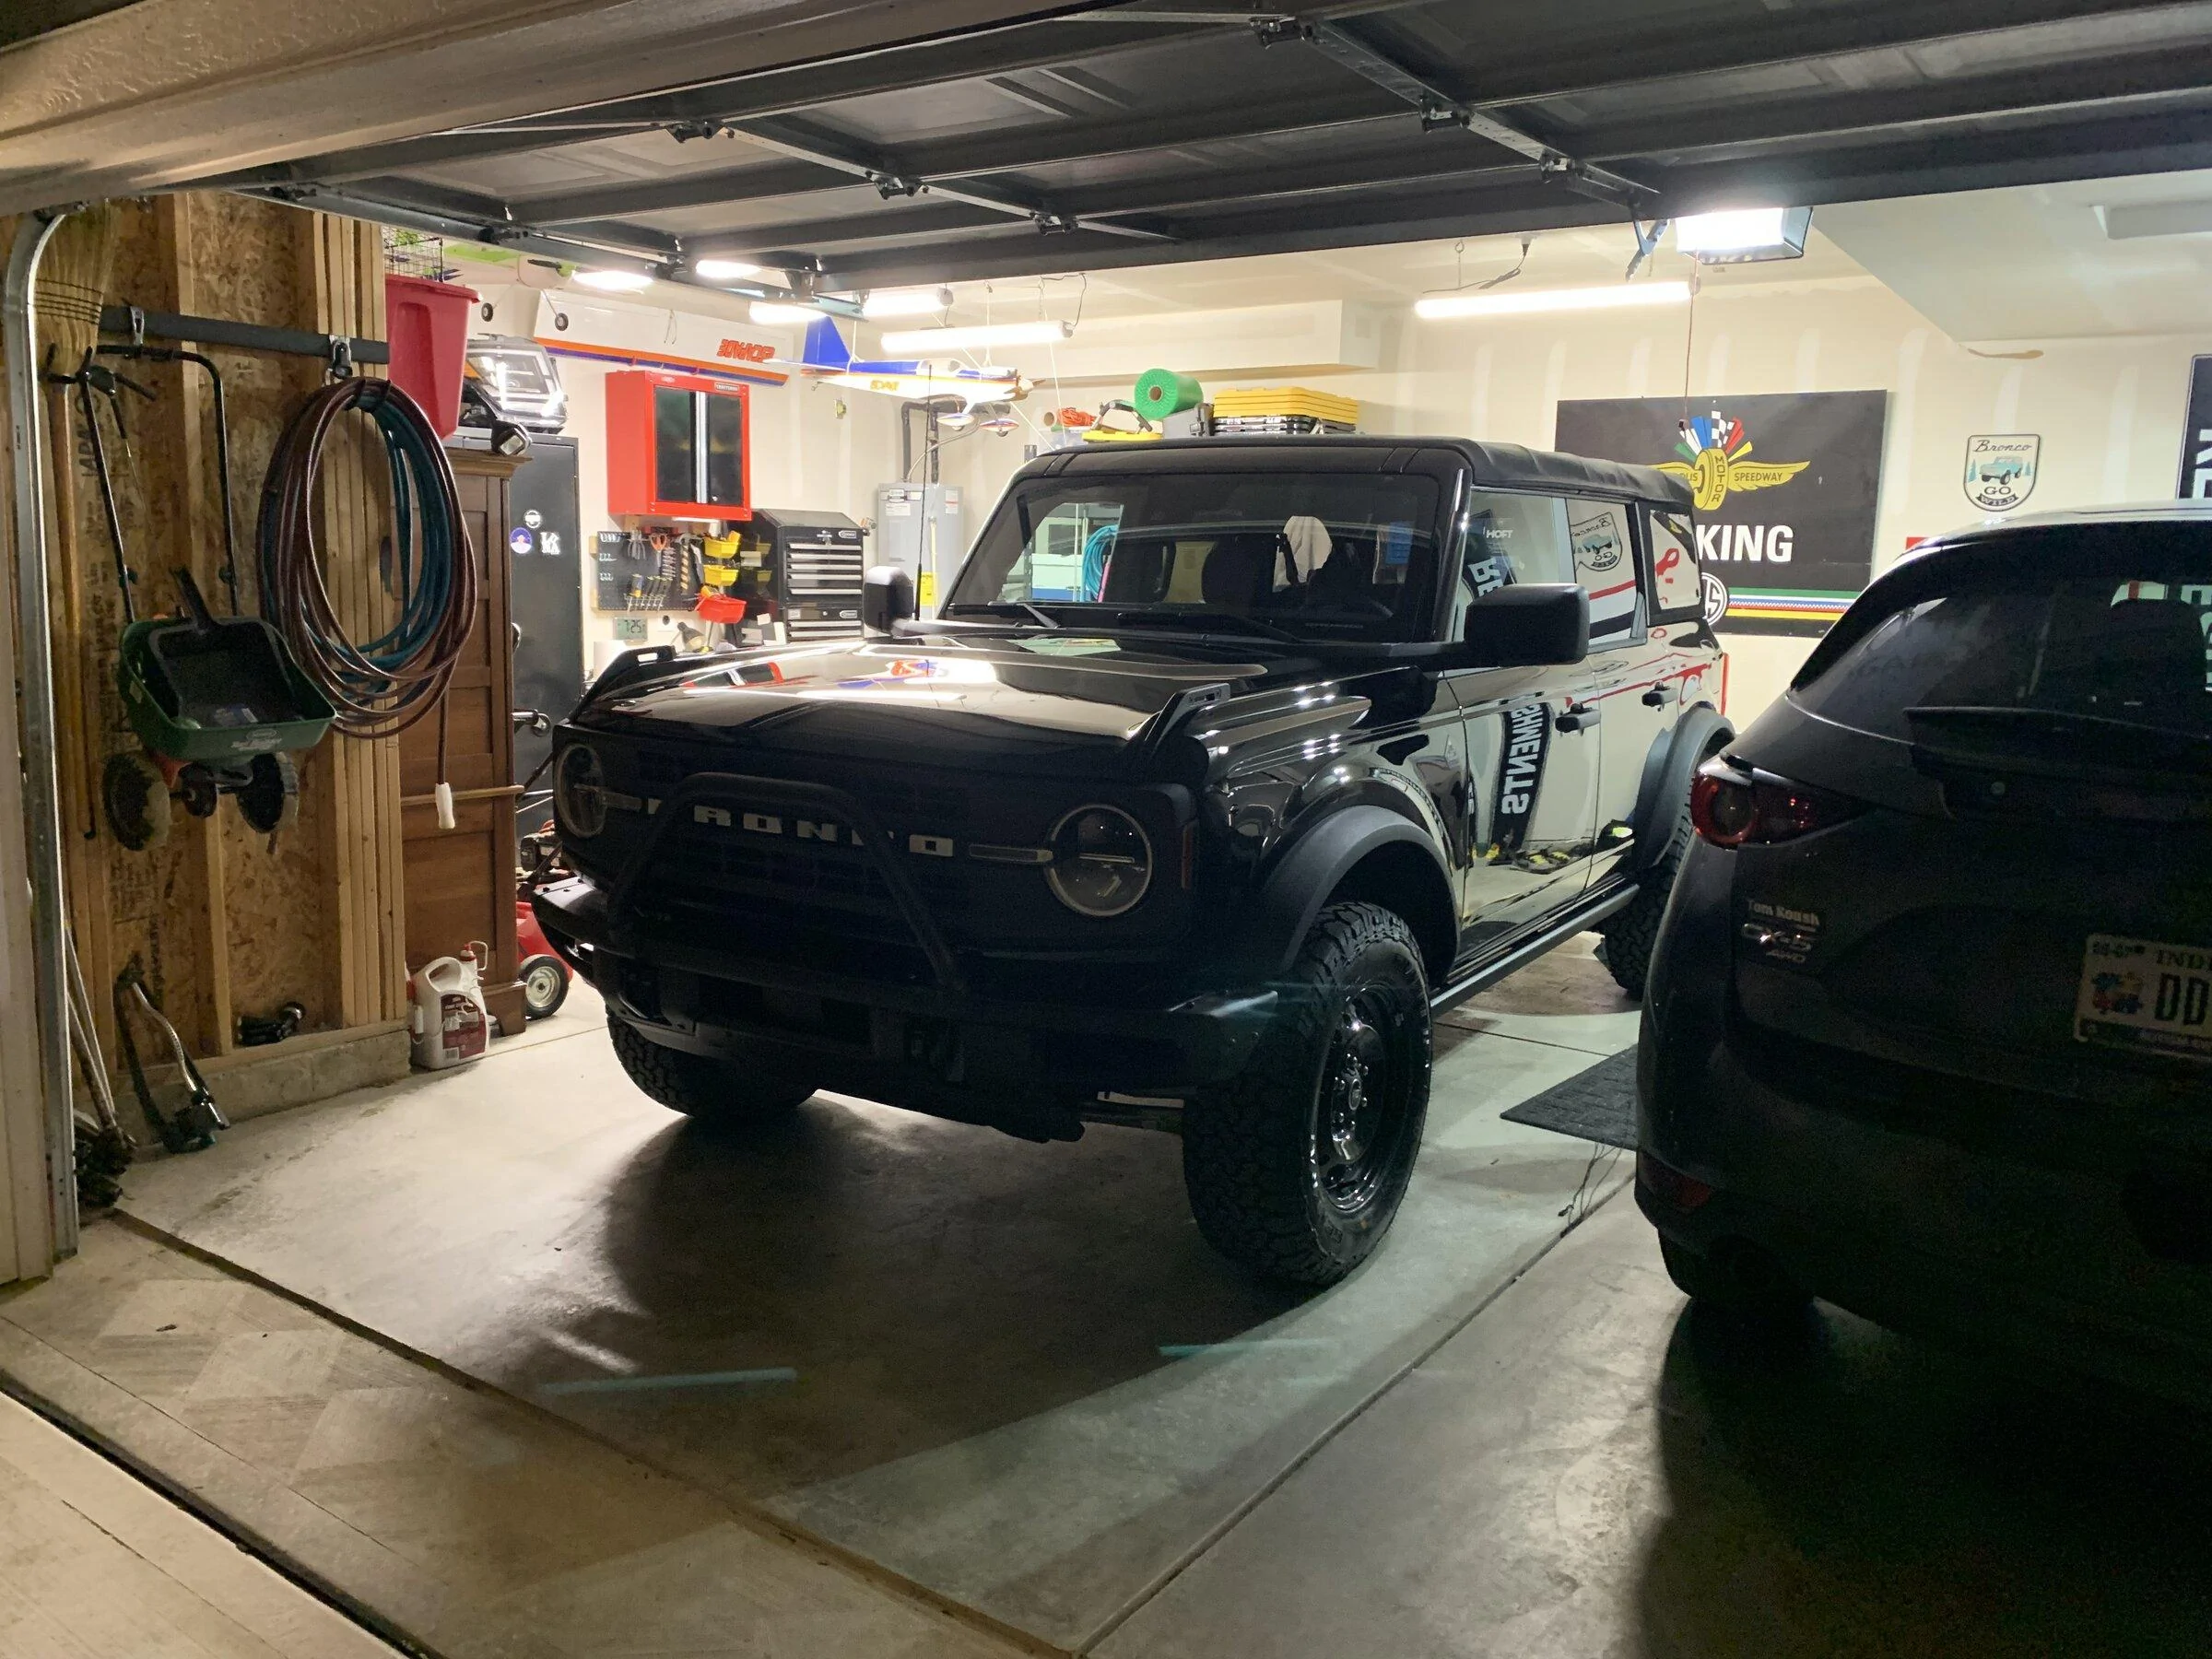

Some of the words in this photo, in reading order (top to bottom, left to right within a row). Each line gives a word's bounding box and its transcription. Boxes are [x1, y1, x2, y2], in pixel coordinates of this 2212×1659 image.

[1973, 440, 2032, 453] Bronco
[1711, 456, 1725, 502] MOTOR
[1734, 473, 1783, 482] SPEEDWAY
[1983, 486, 2011, 495] GO
[1981, 495, 2016, 506] WILD
